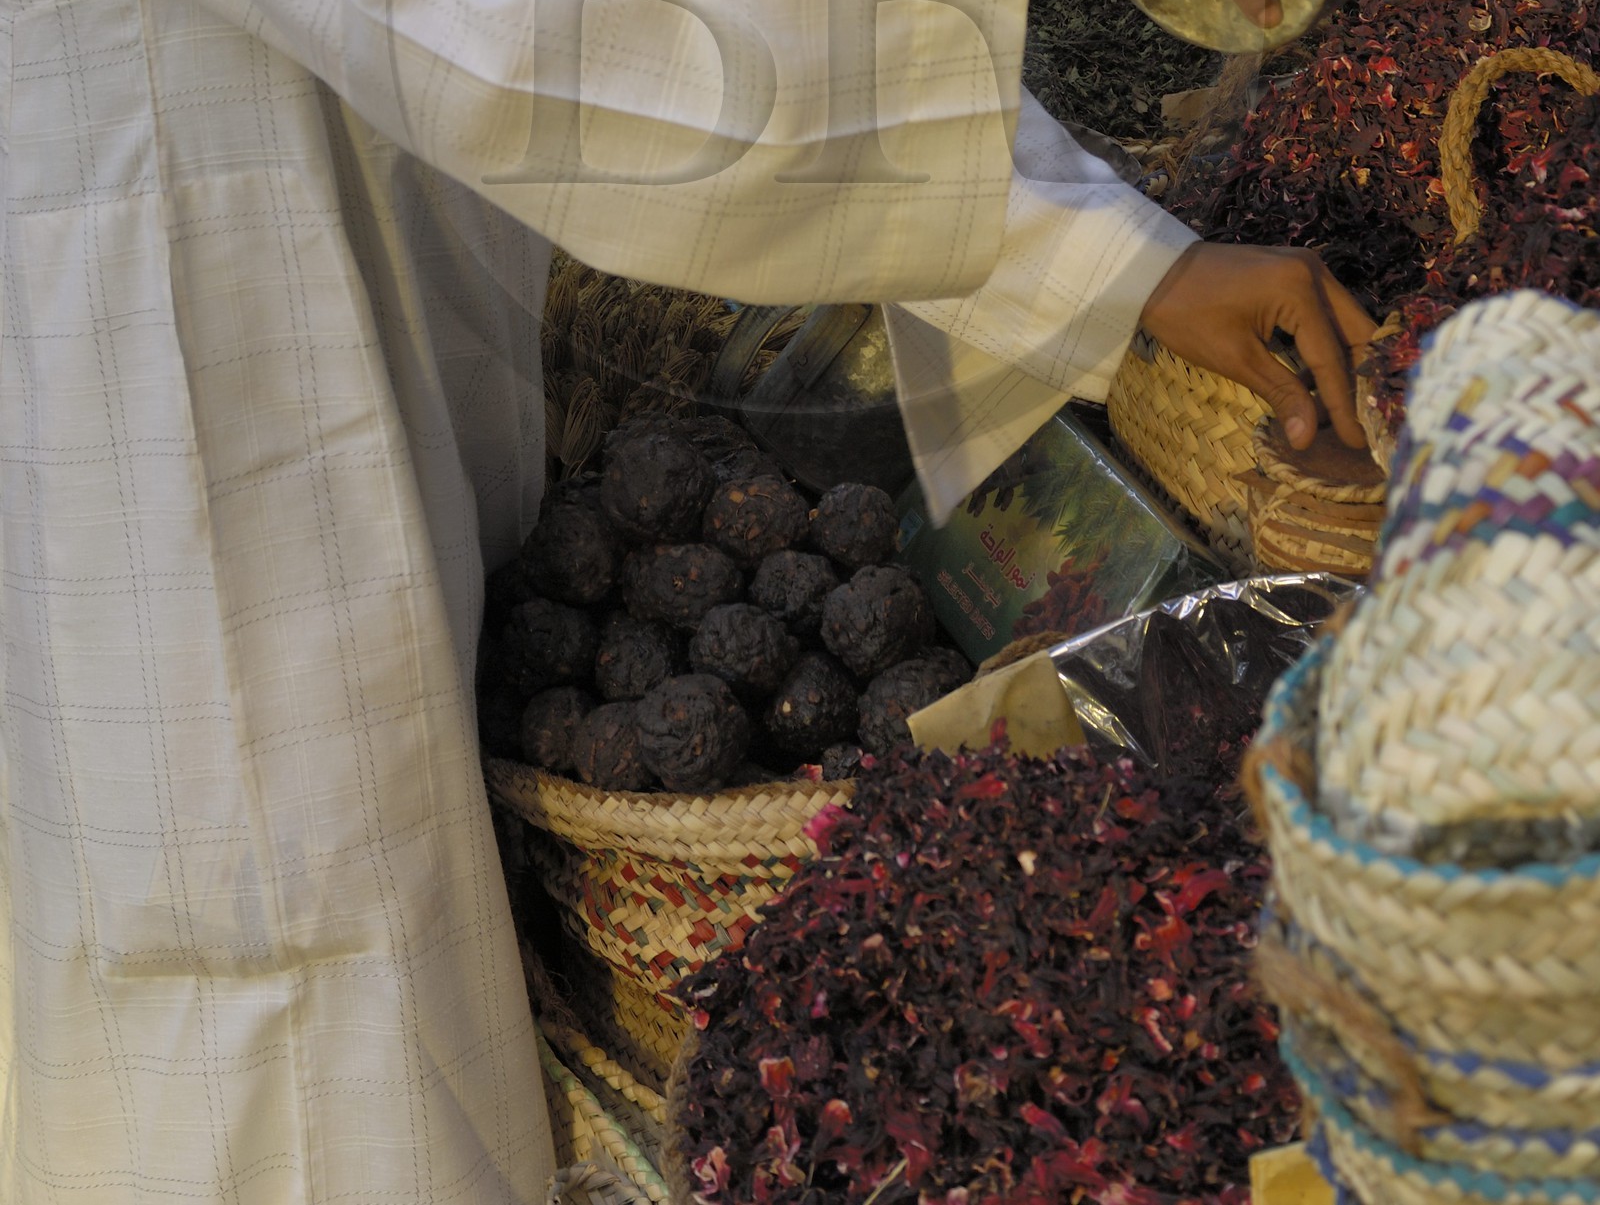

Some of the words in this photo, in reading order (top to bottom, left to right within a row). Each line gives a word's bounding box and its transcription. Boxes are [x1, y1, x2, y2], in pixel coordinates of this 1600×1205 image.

[979, 523, 1016, 571] الواحة
[1005, 564, 1035, 591] تمور
[936, 570, 974, 614] SELECTED
[969, 608, 996, 641] DATES
